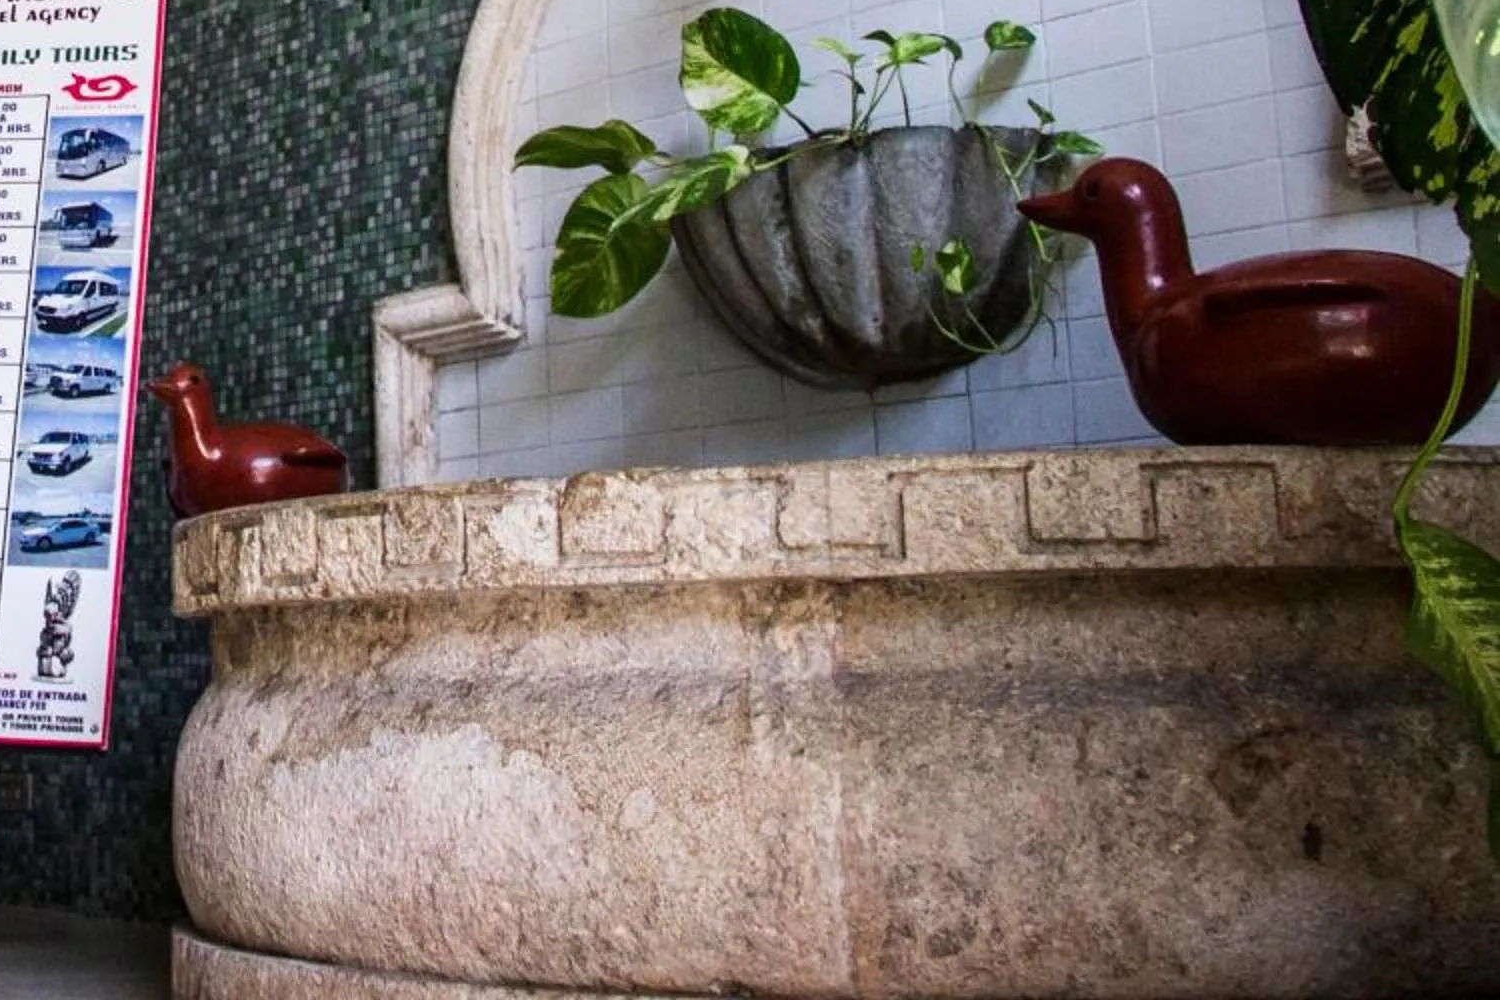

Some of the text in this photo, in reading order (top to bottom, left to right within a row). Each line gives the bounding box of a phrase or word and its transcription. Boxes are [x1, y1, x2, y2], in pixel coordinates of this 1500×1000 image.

[51, 44, 138, 64] TOURS
[0, 114, 7, 123] A
[19, 690, 32, 700] DE
[37, 690, 88, 702] ENTRADA
